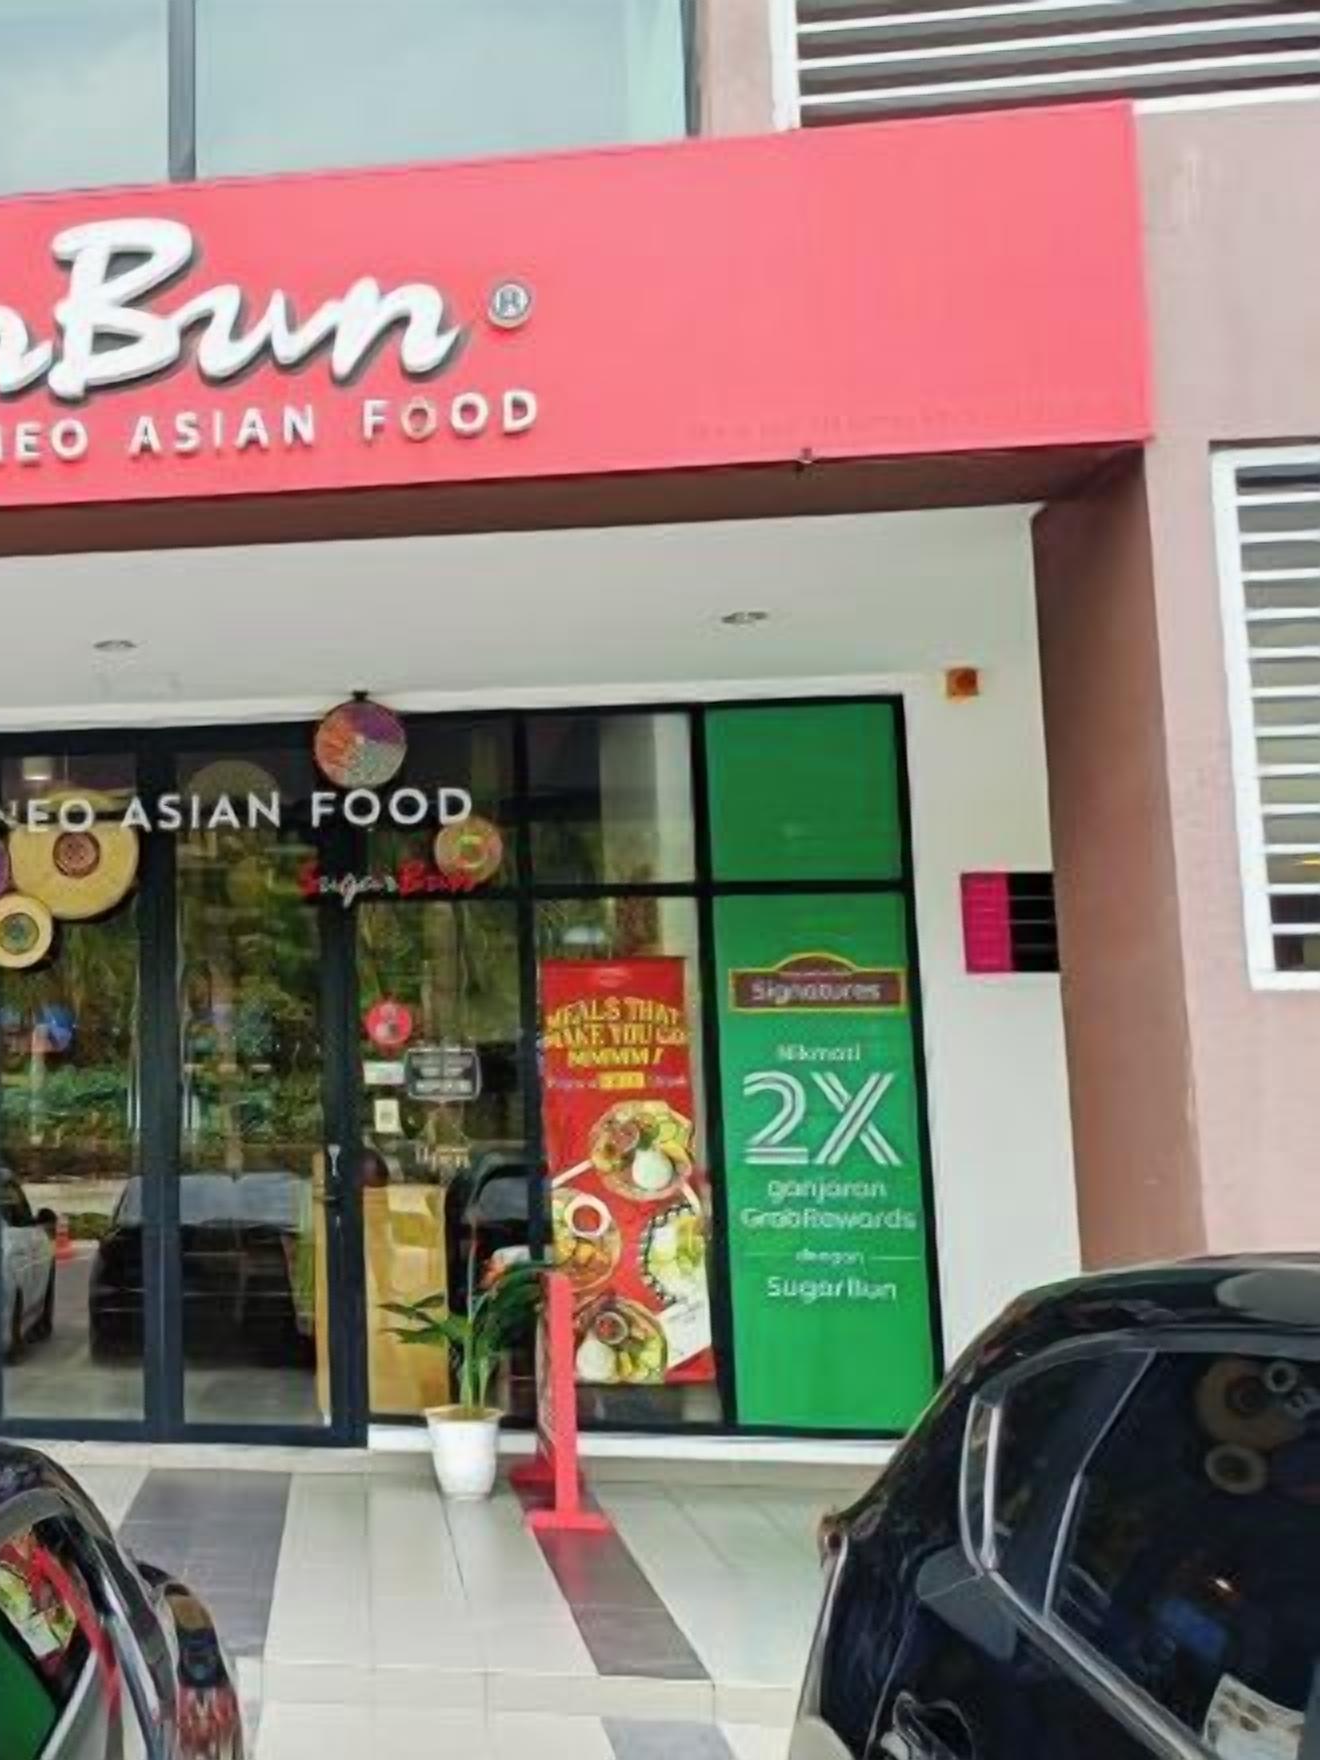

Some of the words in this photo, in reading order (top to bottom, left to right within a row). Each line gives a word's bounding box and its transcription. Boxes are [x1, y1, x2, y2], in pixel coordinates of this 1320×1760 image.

[128, 405, 314, 456] ASIAN
[362, 390, 538, 441] FOOD
[120, 791, 280, 832] ASIAN
[311, 787, 473, 828] FOOD
[742, 1070, 903, 1168] 2X
